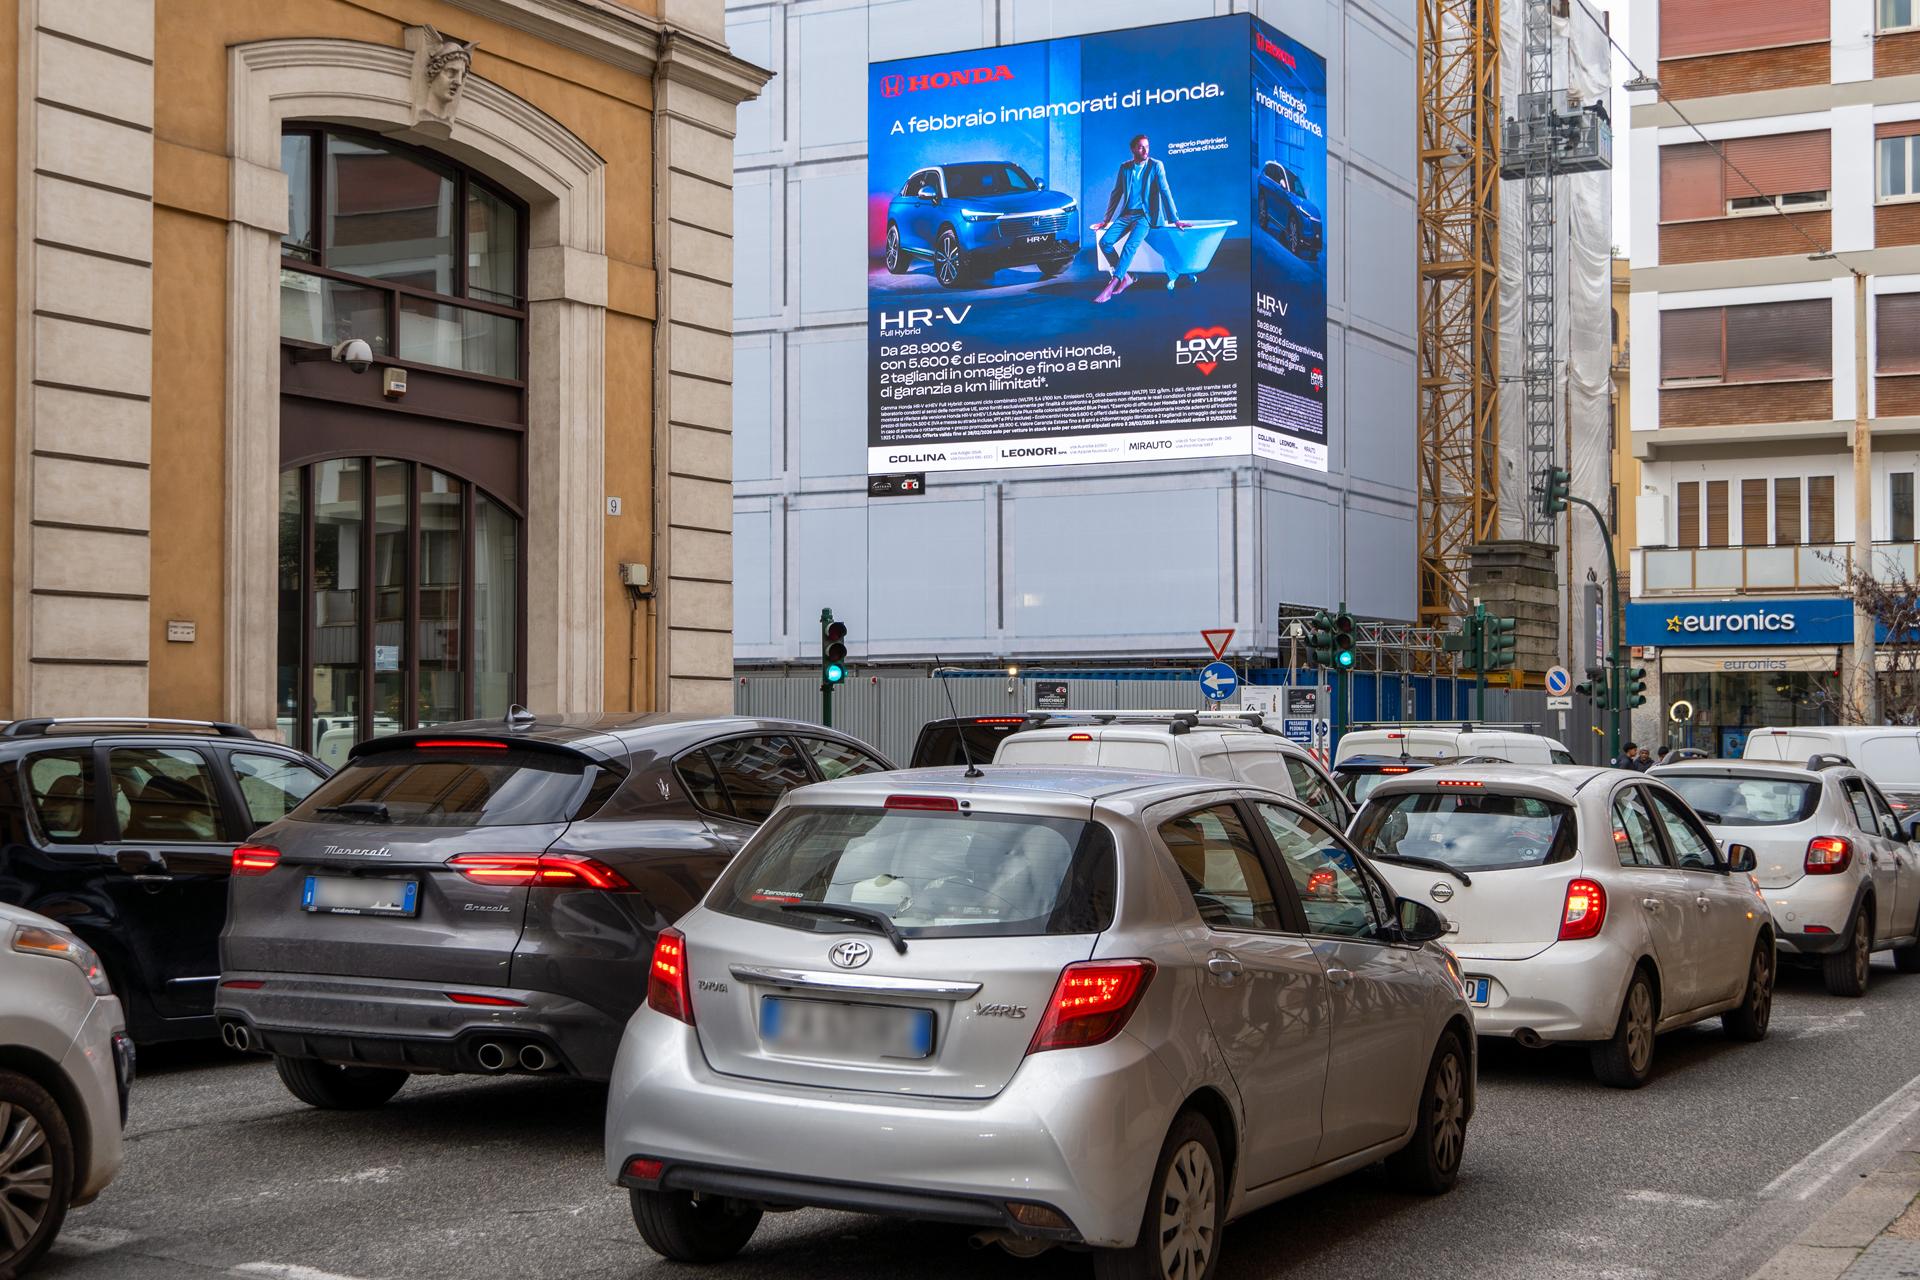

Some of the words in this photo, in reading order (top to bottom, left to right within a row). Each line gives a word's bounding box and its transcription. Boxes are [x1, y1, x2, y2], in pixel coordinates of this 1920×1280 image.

[908, 64, 1016, 92] HONDA
[1273, 85, 1279, 98] A
[1279, 86, 1307, 114] febbraio
[890, 120, 904, 136] A
[908, 108, 996, 133] febbraio
[1000, 92, 1118, 123] innamorati
[1122, 89, 1140, 108] di
[1146, 82, 1224, 106] Honda.
[1256, 88, 1293, 121] innamorati
[1300, 114, 1323, 138] Honda.
[1168, 140, 1196, 148] Gregorio
[1026, 235, 1048, 243] HR-V
[1257, 292, 1288, 316] HR-V
[880, 305, 972, 330] HR-V
[895, 328, 921, 337] Hybrid
[880, 346, 898, 357] Da
[900, 342, 950, 355] 28.900
[952, 341, 962, 352] €
[1176, 336, 1238, 352] LOVE
[880, 360, 906, 370] con
[908, 356, 949, 369] 5.600
[951, 355, 961, 365] €
[963, 353, 976, 365] di
[978, 346, 1063, 364] Ecoincentivi
[1066, 344, 1116, 358] Honda,
[1176, 349, 1238, 364] DAYS
[880, 374, 889, 384] 2
[891, 368, 948, 385] tagliandi
[950, 368, 961, 380] in
[964, 364, 1024, 380] omaggio
[1026, 365, 1035, 374] e
[1037, 362, 1064, 374] fino
[1066, 362, 1076, 372] a
[1078, 360, 1088, 371] 8
[1090, 356, 1121, 370] anni
[880, 386, 892, 398] di
[894, 383, 952, 400] garanzia
[954, 384, 963, 394] a
[965, 382, 987, 392] km
[1258, 434, 1275, 443] COLLINA
[888, 453, 946, 464] COLLINA
[1001, 447, 1057, 458] LEONORI
[1129, 440, 1172, 450] MIRAUTO
[610, 499, 616, 513] 9
[1684, 609, 1795, 632] euronics
[1724, 658, 1787, 670] euronics
[324, 845, 392, 857] Maserati
[764, 890, 804, 898] Zerocento
[464, 904, 510, 912] Grecale
[698, 980, 728, 992] TOYOTA
[976, 1002, 1027, 1019] YARIS
